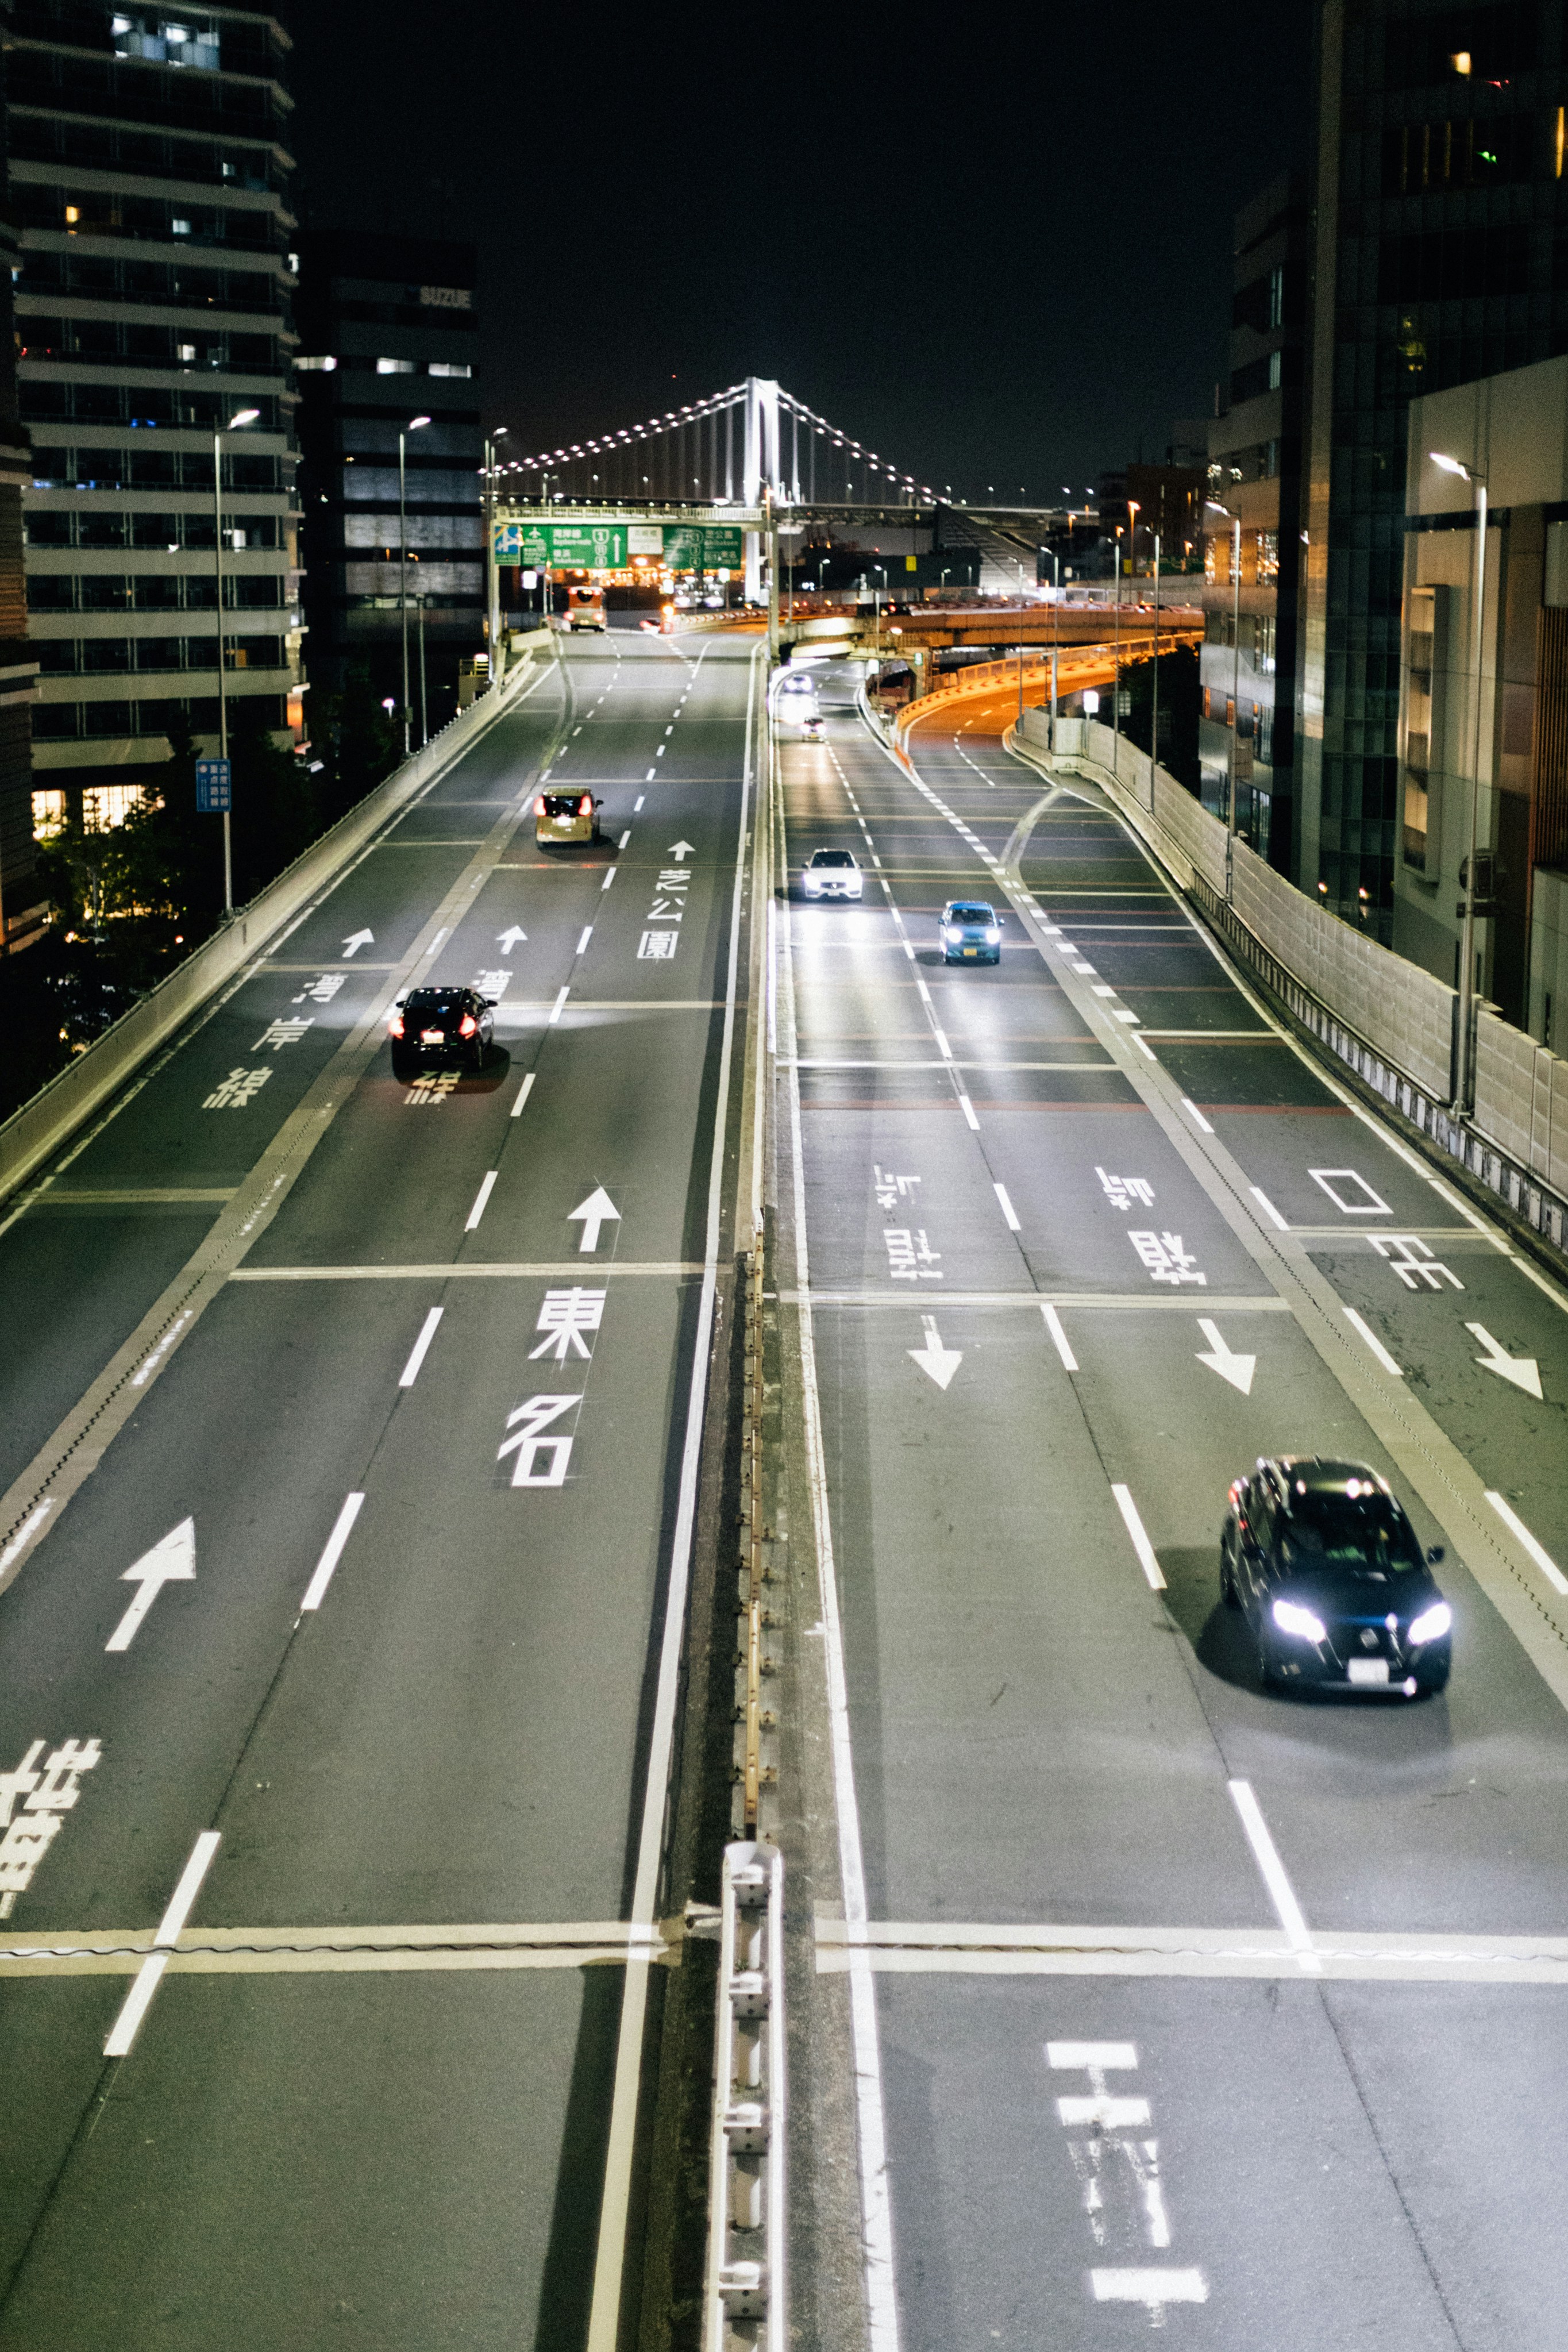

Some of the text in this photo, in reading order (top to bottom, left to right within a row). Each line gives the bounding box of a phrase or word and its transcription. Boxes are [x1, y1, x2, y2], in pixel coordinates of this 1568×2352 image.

[637, 869, 691, 959] 芝公園
[1095, 1167, 1207, 1285] 箱崎
[1308, 1169, 1466, 1289] 出口
[497, 1287, 607, 1487] 東名
